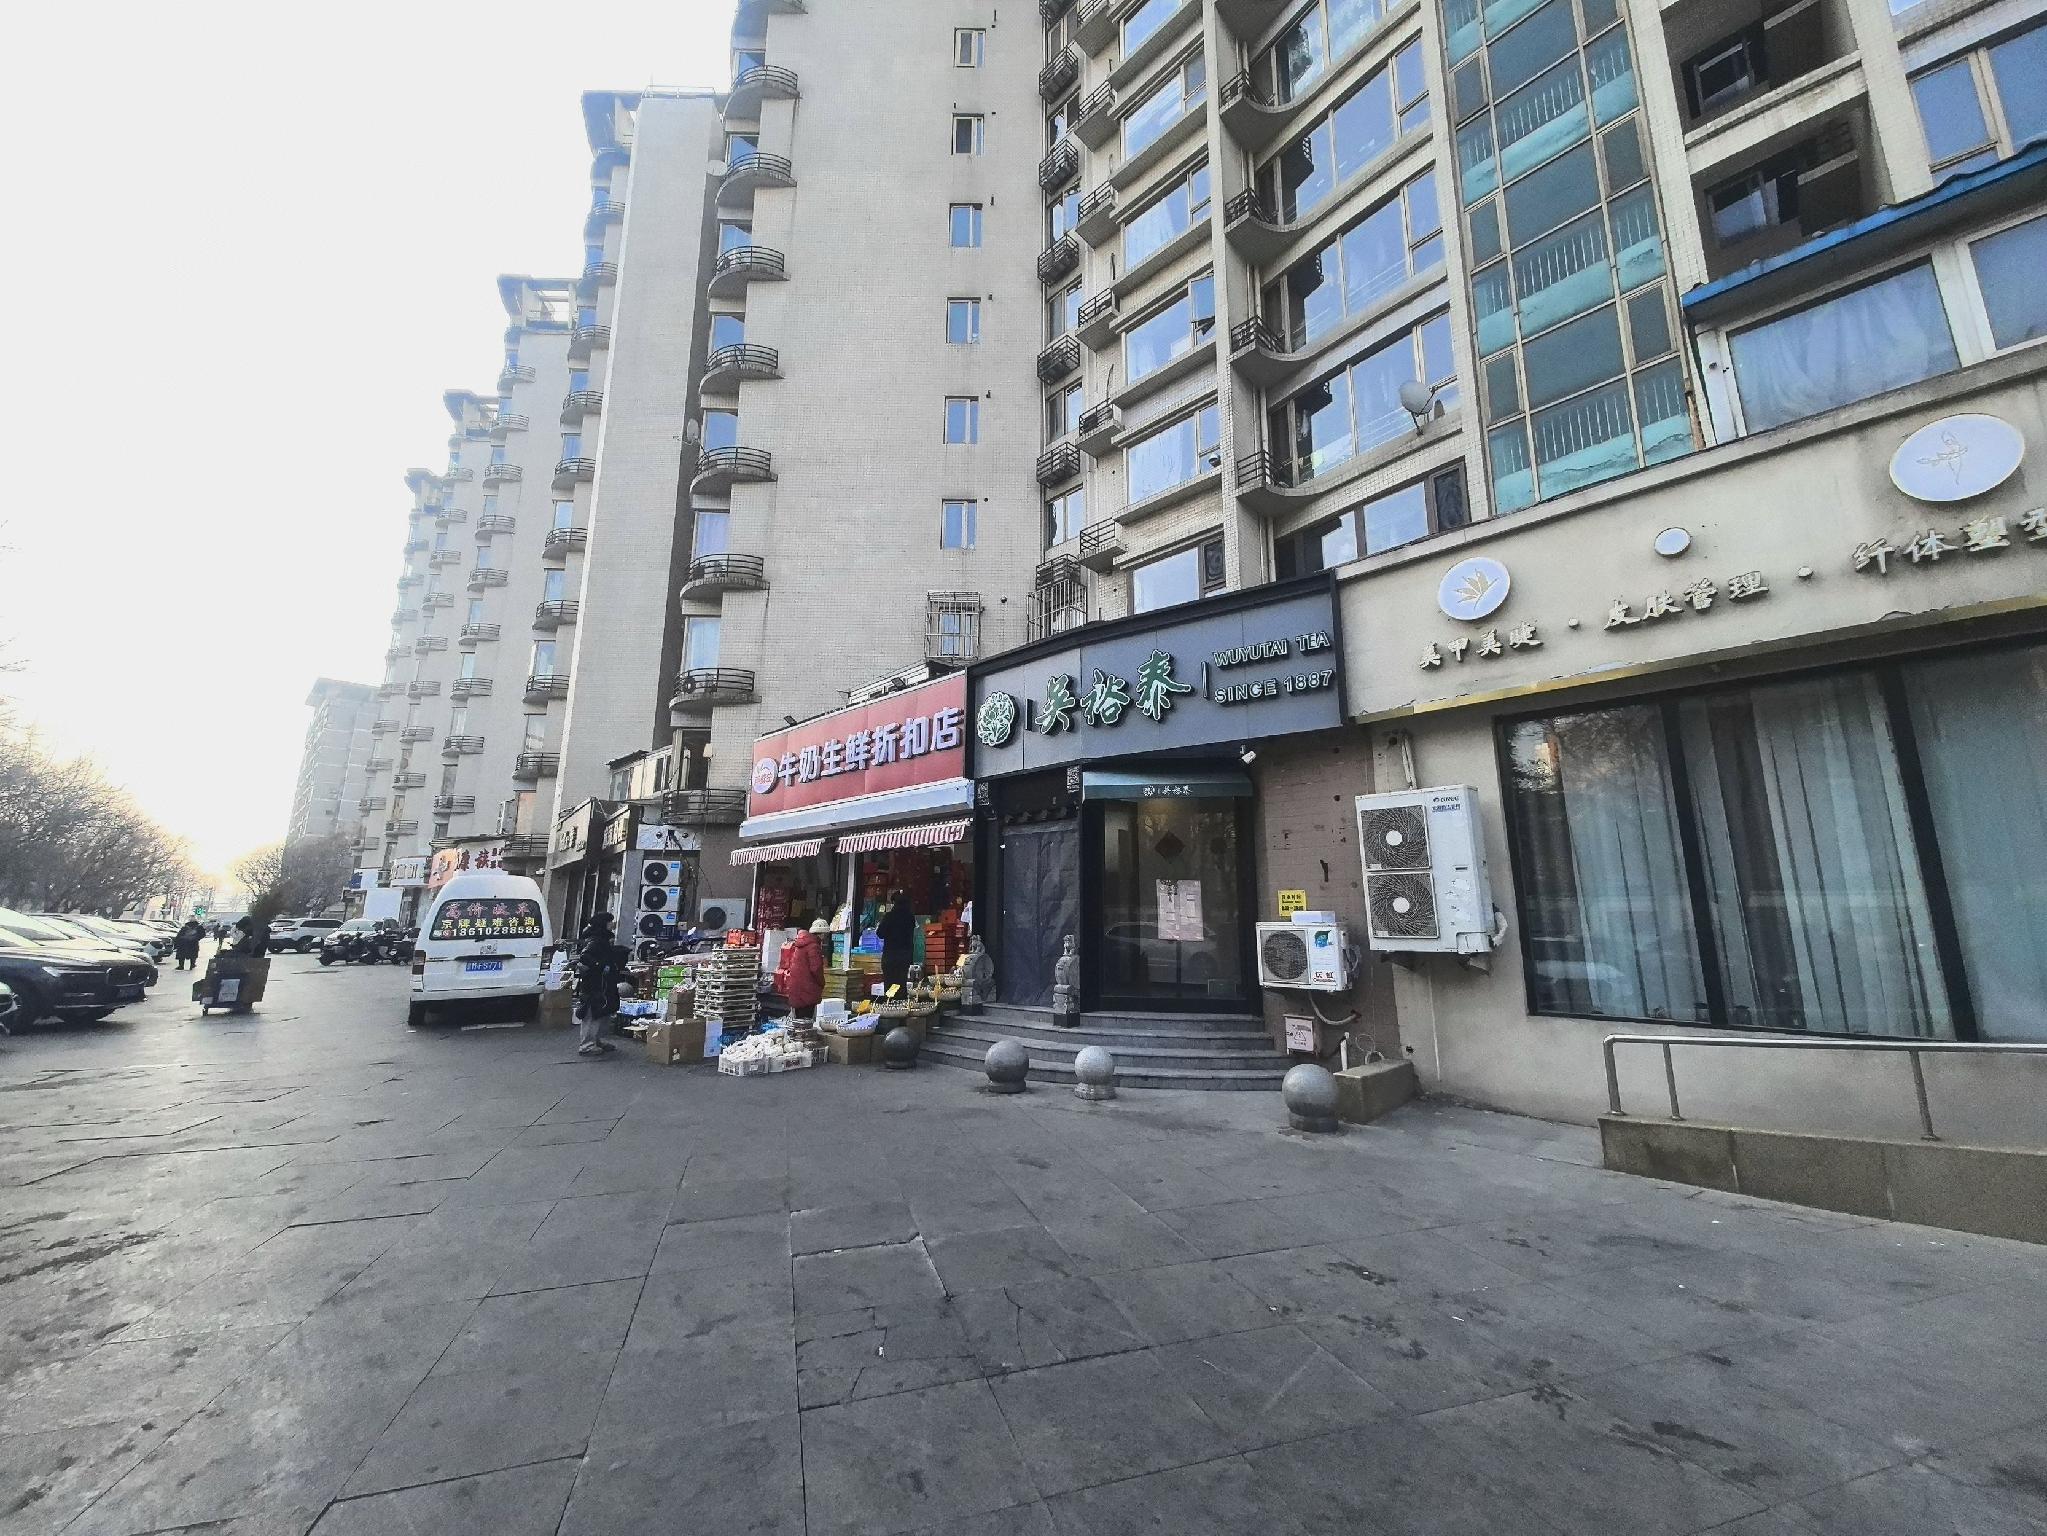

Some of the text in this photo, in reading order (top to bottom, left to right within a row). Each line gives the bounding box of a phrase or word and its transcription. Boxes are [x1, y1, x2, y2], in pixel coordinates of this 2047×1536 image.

[1213, 631, 1330, 667] WUYUTAI TEA
[1419, 620, 1544, 670] 美甲美睫
[1604, 570, 1770, 631] 皮肤管理
[1035, 650, 1192, 735] 吴裕泰
[1214, 669, 1333, 704] SINCE 1887
[778, 706, 964, 787] 牛奶生鲜折扣店
[441, 917, 535, 929] 京牌疑难咨询
